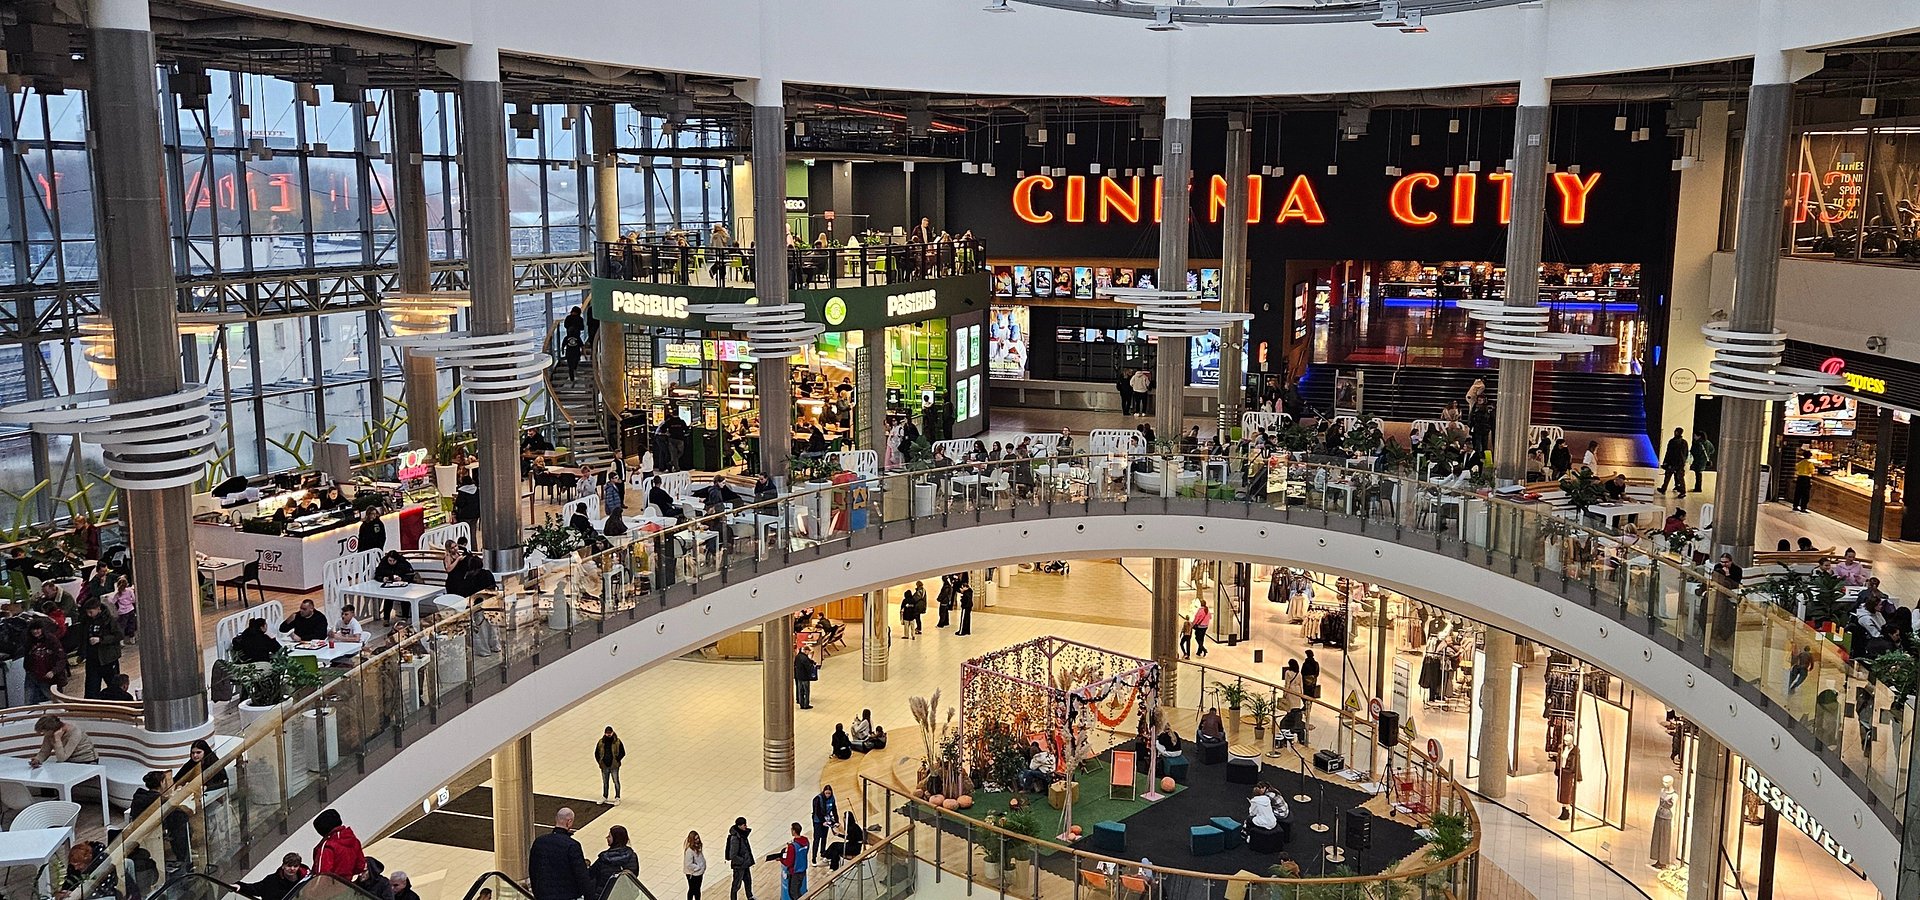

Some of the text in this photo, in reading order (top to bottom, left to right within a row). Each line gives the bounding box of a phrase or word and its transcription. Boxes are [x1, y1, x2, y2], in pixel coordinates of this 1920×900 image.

[1013, 175, 1325, 223] CINMA
[1802, 394, 1845, 413] 6,29
[398, 448, 427, 470] TOP
[255, 549, 282, 563] TOP
[338, 535, 359, 556] TO
